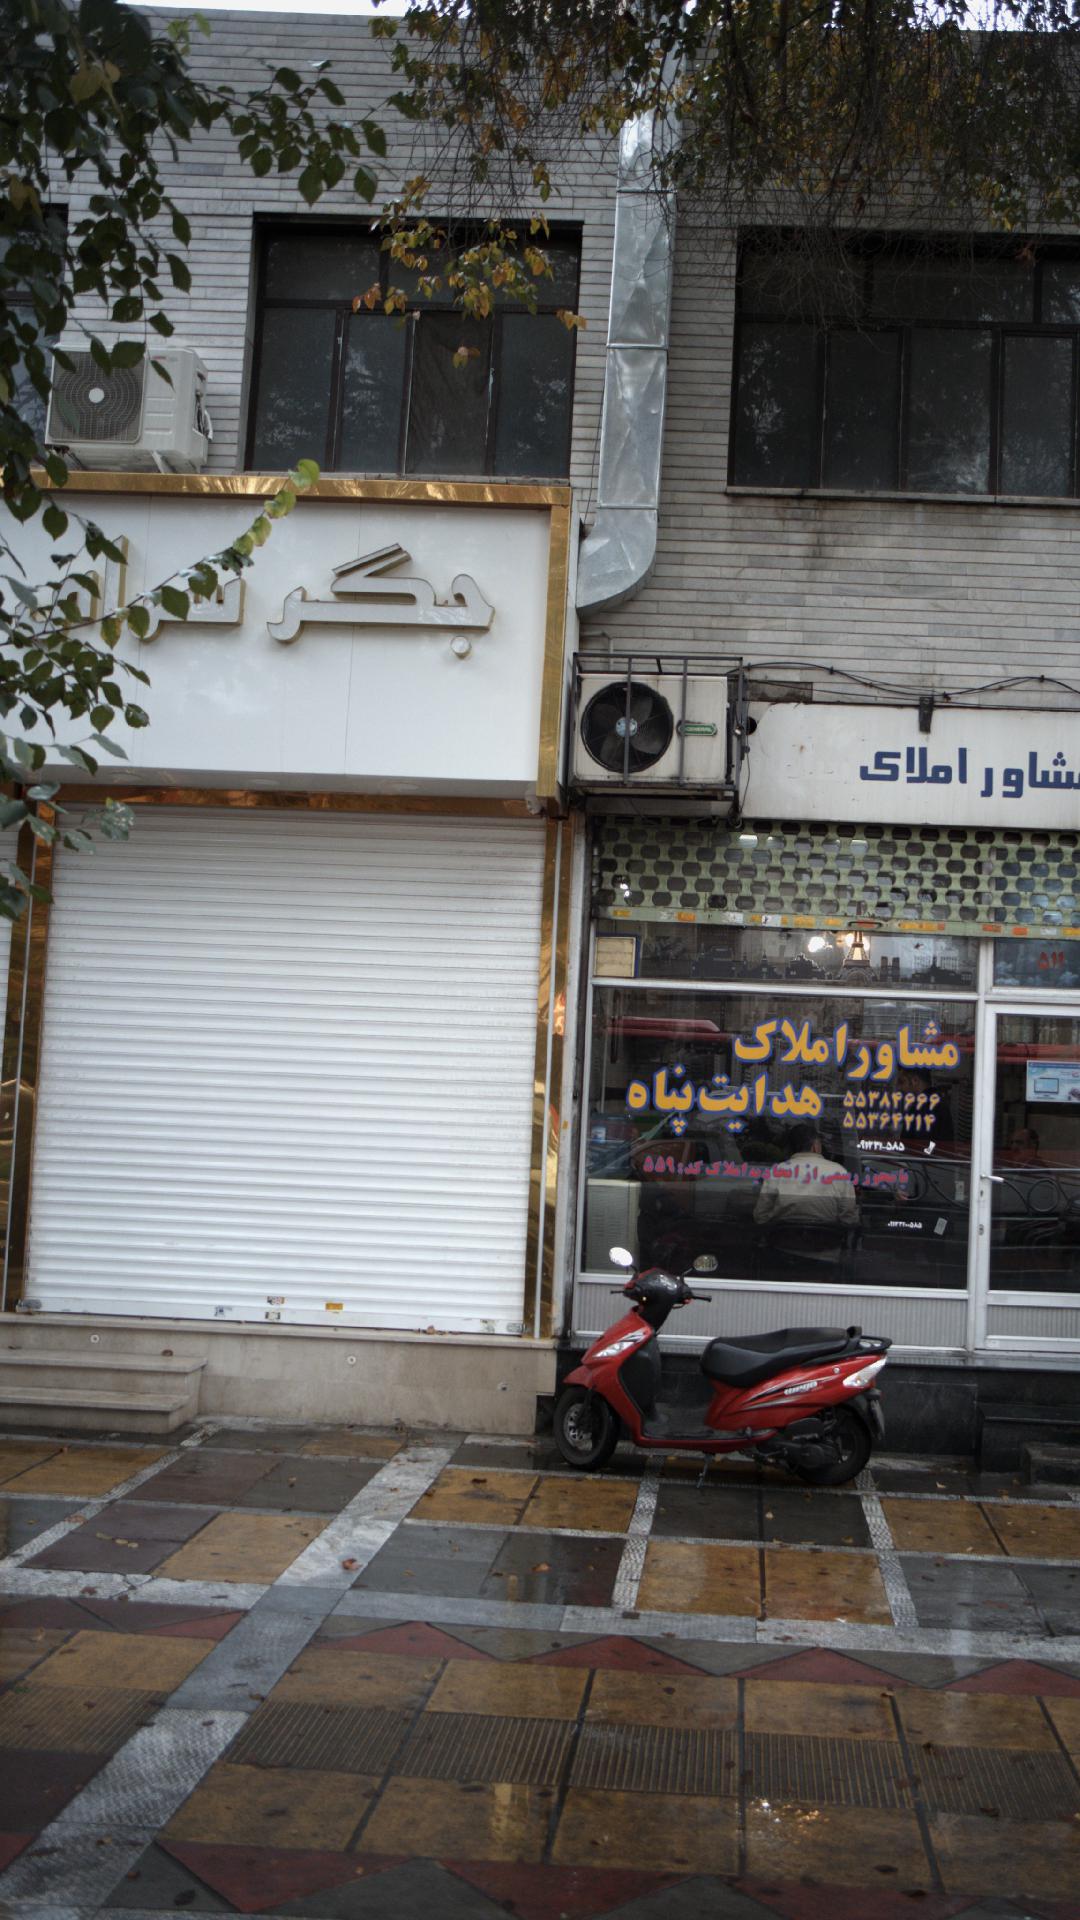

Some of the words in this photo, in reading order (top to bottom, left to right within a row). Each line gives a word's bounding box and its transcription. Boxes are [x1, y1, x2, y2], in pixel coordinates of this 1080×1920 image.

[859, 746, 968, 784] املاک
[733, 1019, 849, 1066] املاک
[847, 1020, 960, 1081] مشاور
[626, 1064, 695, 1135] پناه
[698, 1073, 823, 1133] هدایت
[843, 1089, 941, 1111] ۵۵۳۸۴۶۶۶
